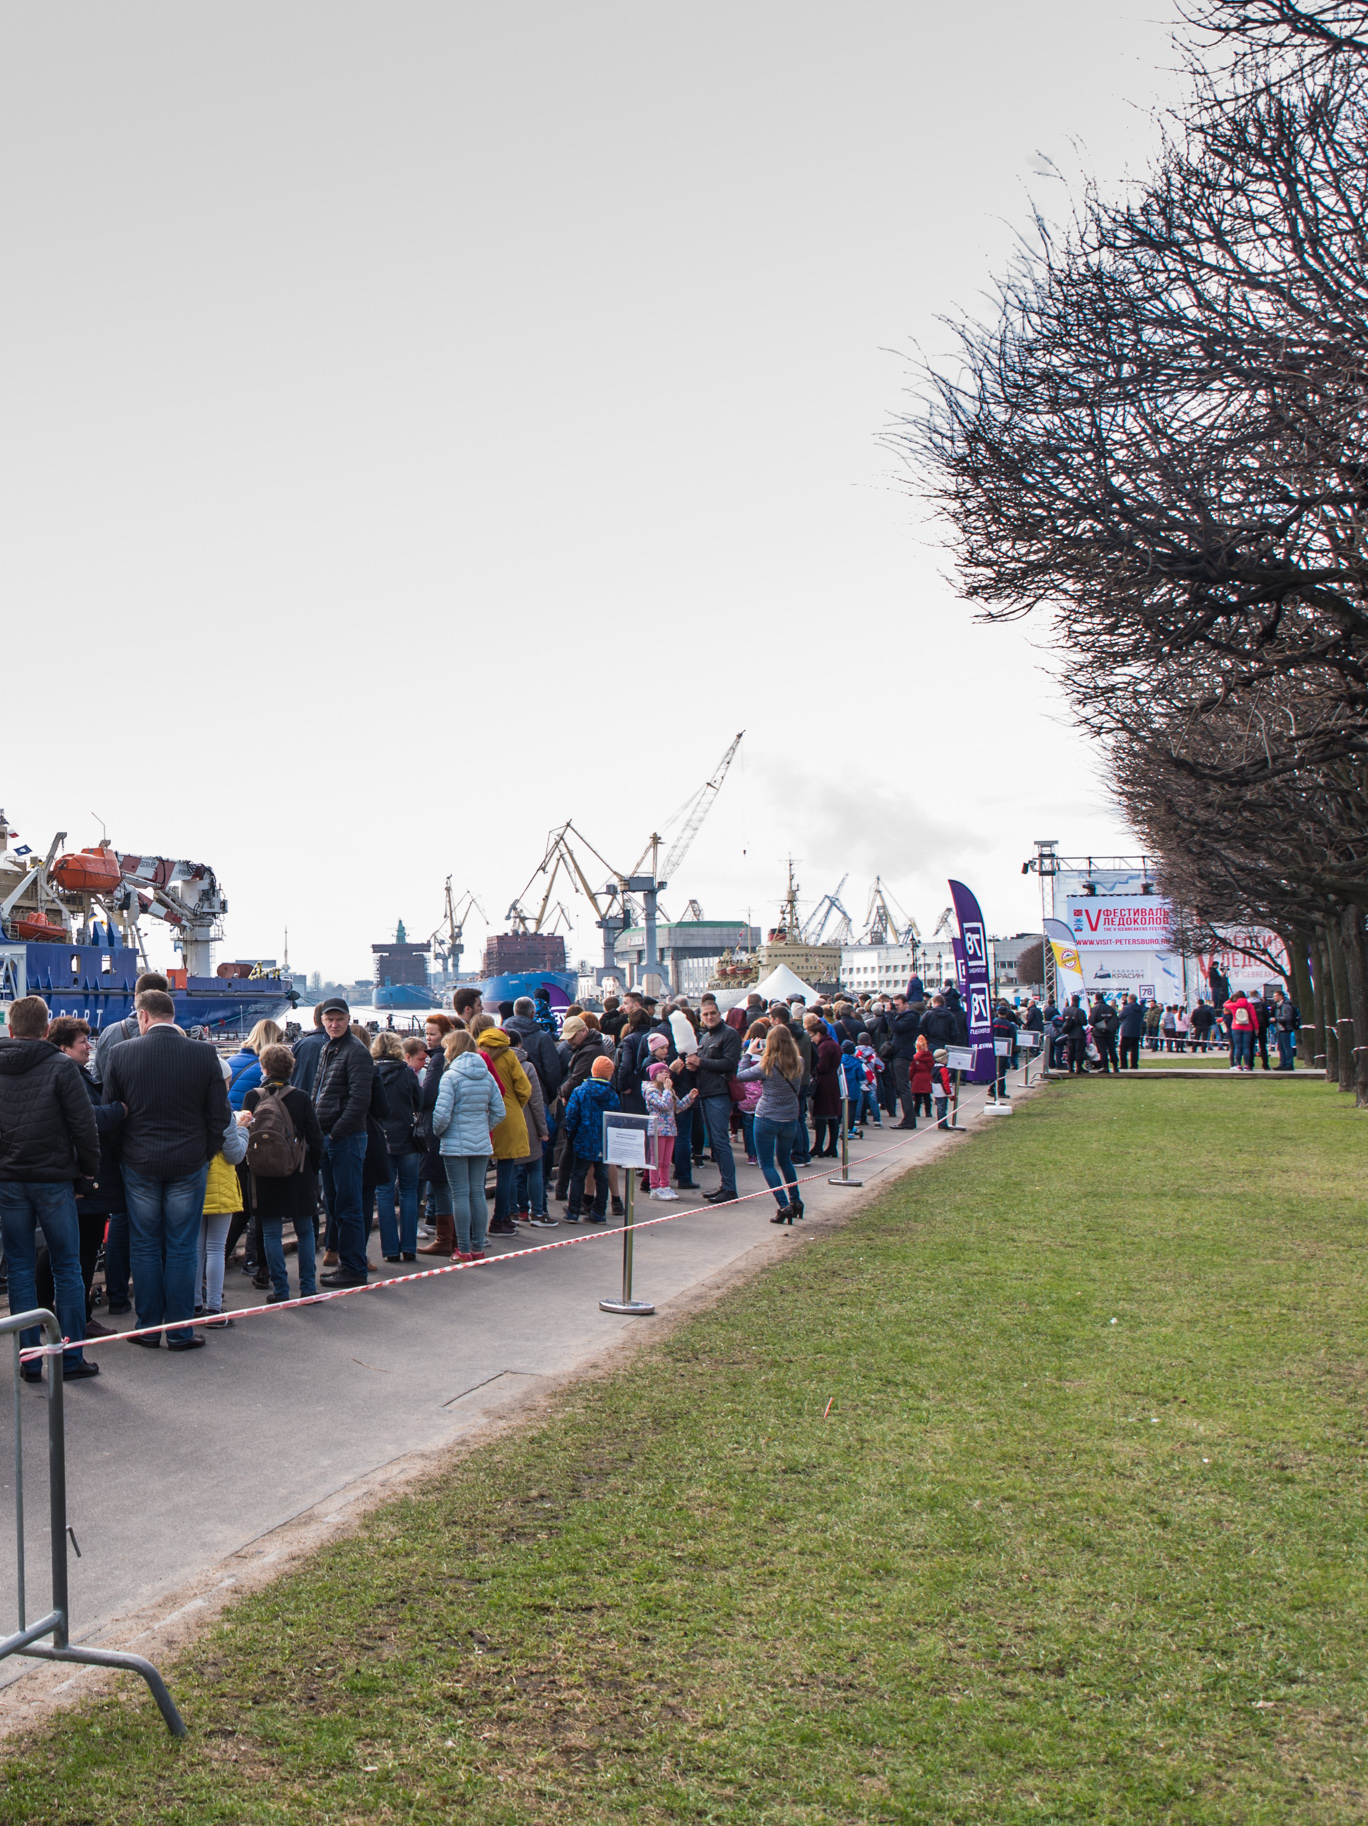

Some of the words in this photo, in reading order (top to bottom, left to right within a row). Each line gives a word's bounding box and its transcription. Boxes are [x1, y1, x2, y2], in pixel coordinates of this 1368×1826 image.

[1102, 908, 1170, 918] ФЕСТИВАЛЬ
[1084, 908, 1102, 932] V
[1102, 917, 1170, 927] ЛЕДОКОЛОВ
[1141, 988, 1153, 997] 78
